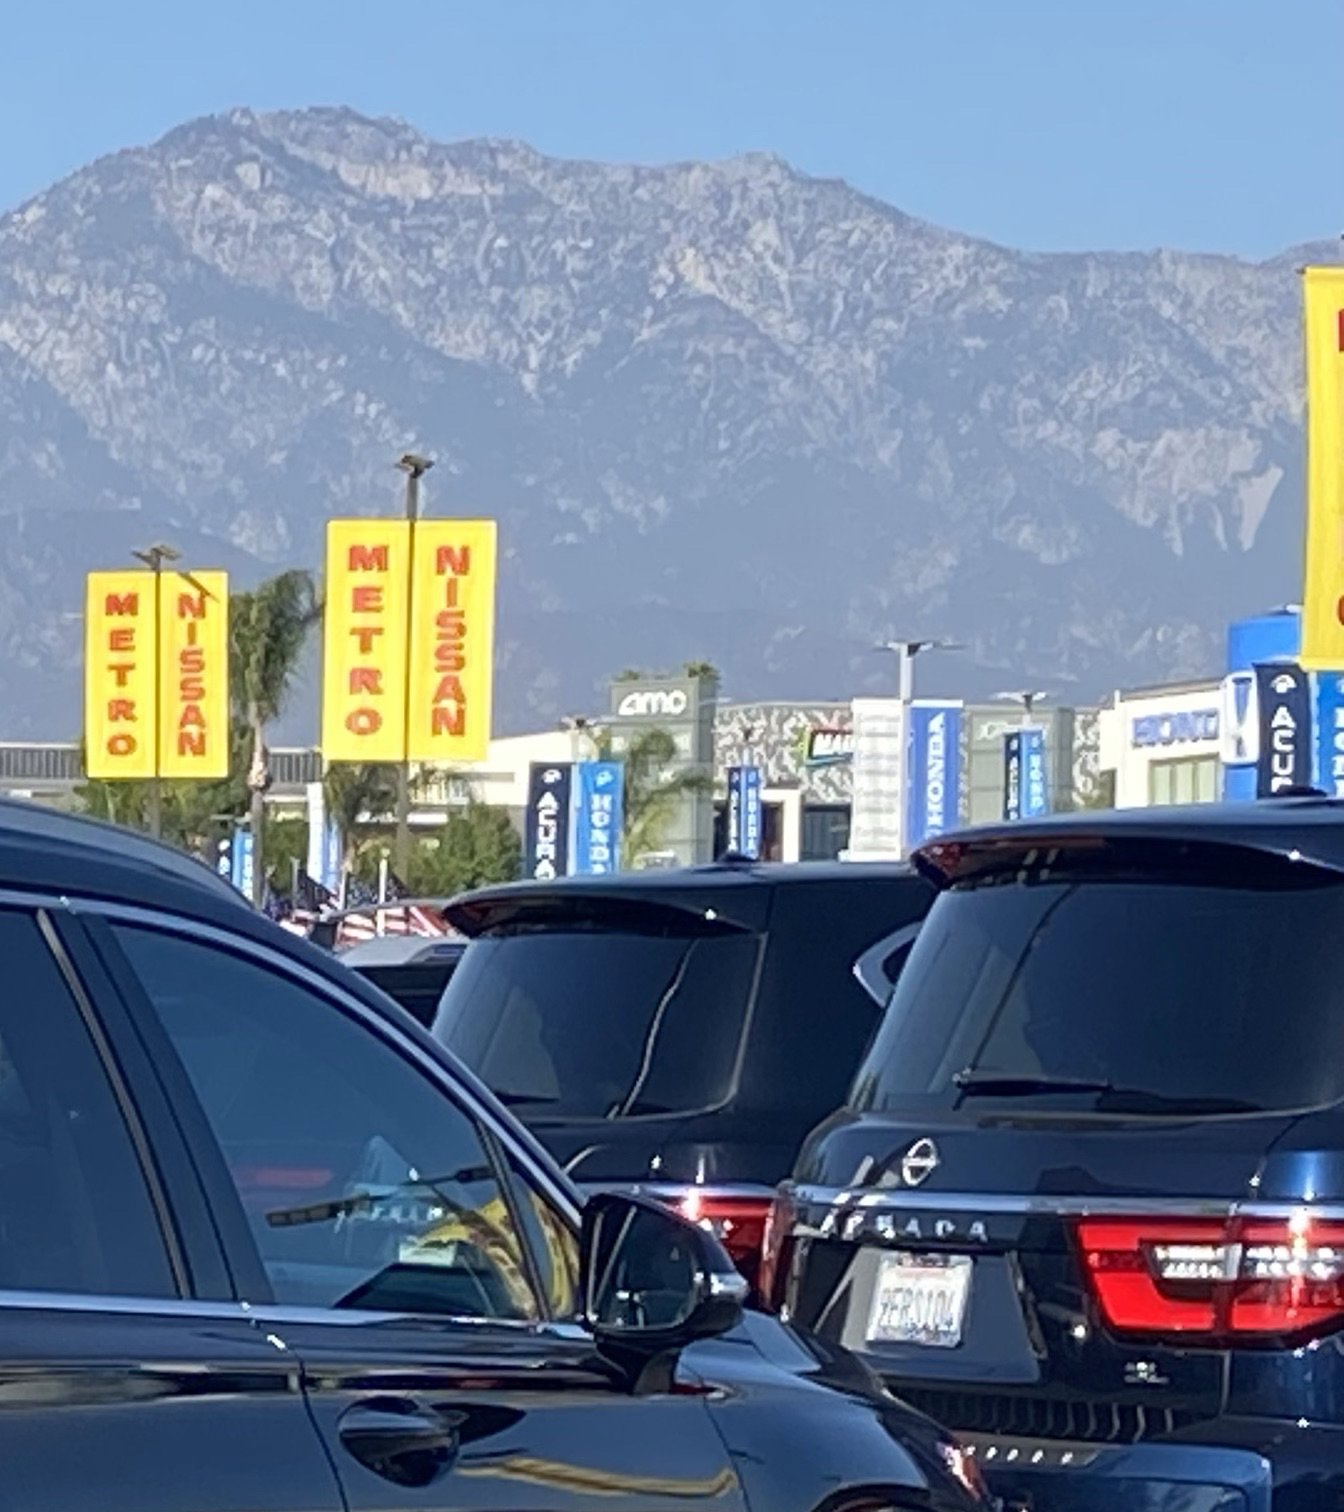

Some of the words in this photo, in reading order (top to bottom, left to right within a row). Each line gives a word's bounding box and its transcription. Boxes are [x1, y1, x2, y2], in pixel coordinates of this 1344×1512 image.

[104, 592, 139, 756] METRO
[177, 592, 207, 757] NISSAN
[344, 544, 390, 736] METRO
[431, 544, 471, 737] NISSAN
